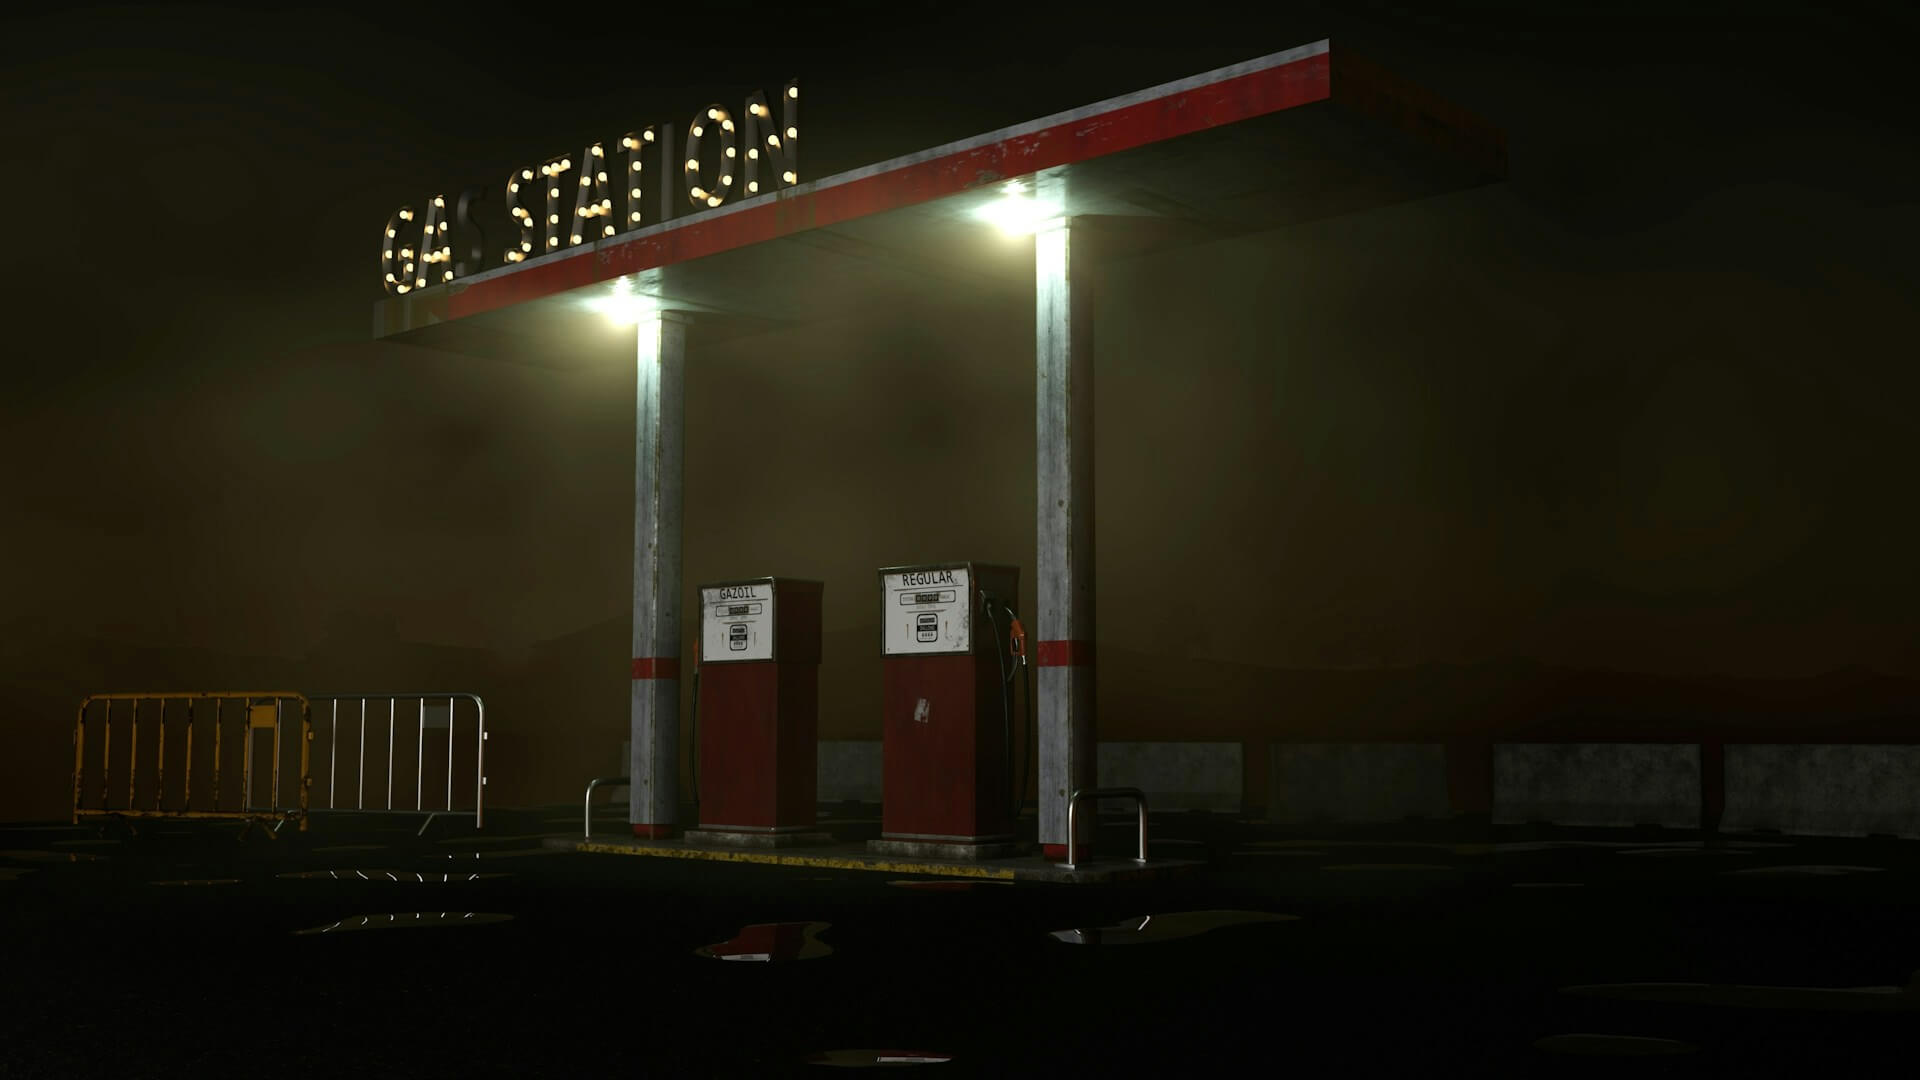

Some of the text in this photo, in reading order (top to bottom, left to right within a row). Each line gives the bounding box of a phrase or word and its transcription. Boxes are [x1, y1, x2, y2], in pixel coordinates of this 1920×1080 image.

[382, 76, 799, 296] GAS STATION
[902, 571, 954, 586] REGULAR
[720, 586, 757, 600] GAZOIL
